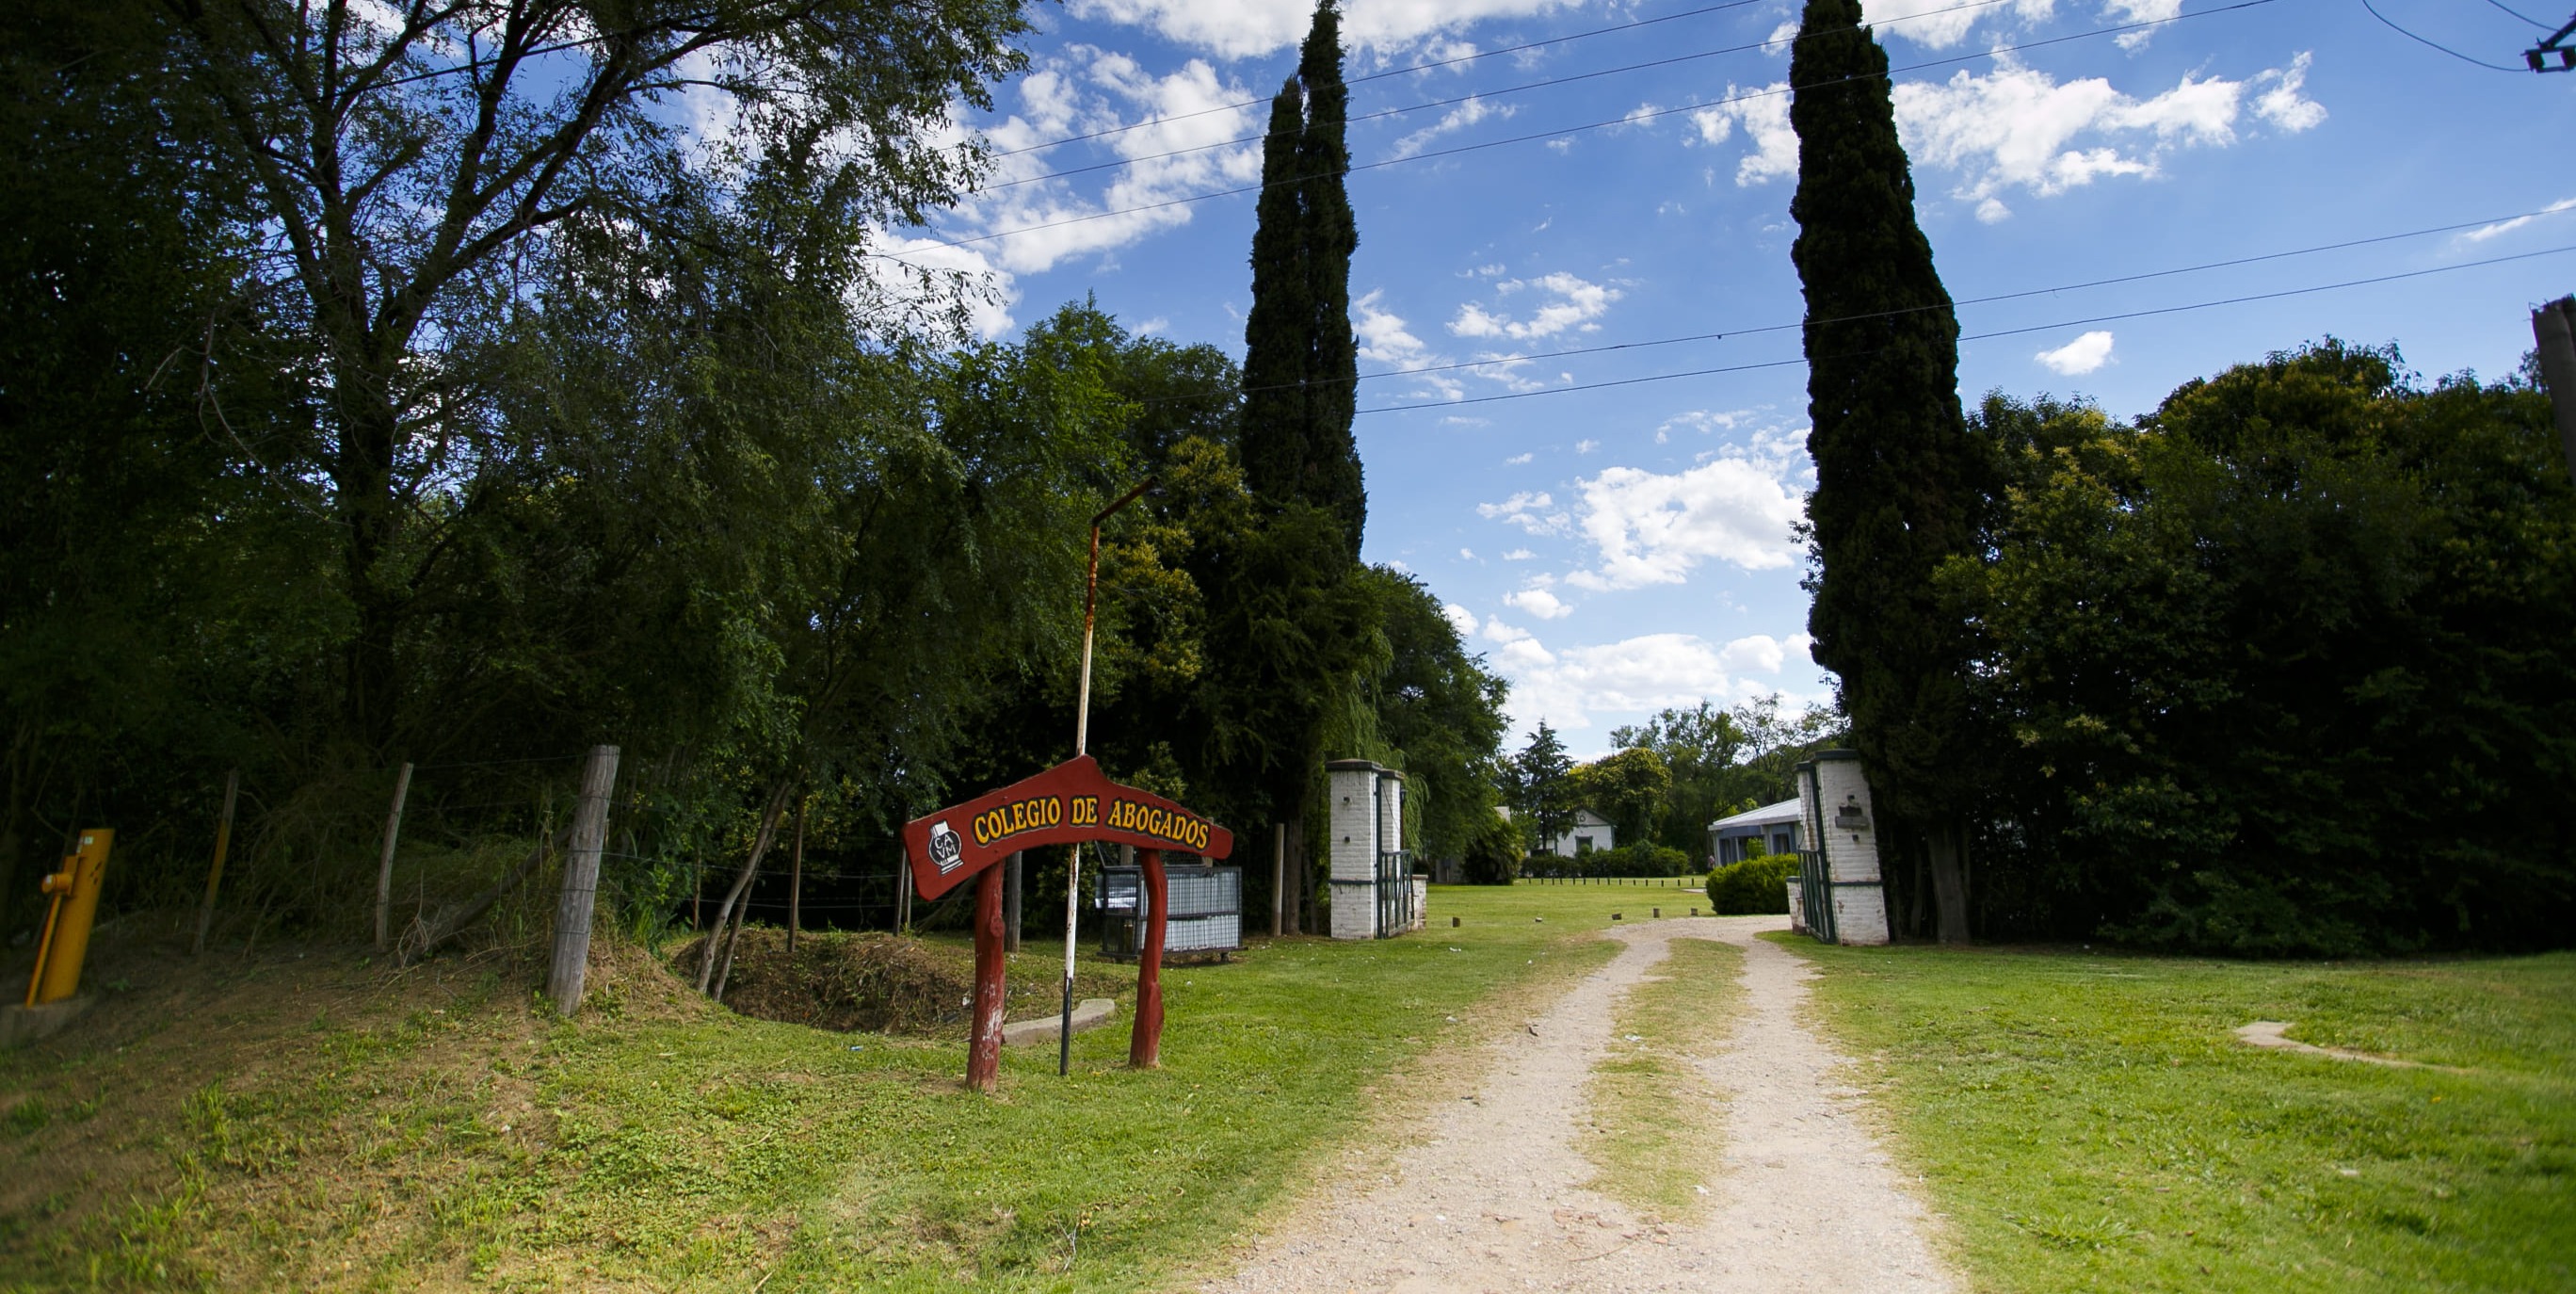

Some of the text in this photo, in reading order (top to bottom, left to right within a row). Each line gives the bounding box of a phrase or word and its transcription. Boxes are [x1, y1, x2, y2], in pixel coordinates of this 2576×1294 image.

[974, 797, 1210, 849] COLEGIO DE ABOGADOS
